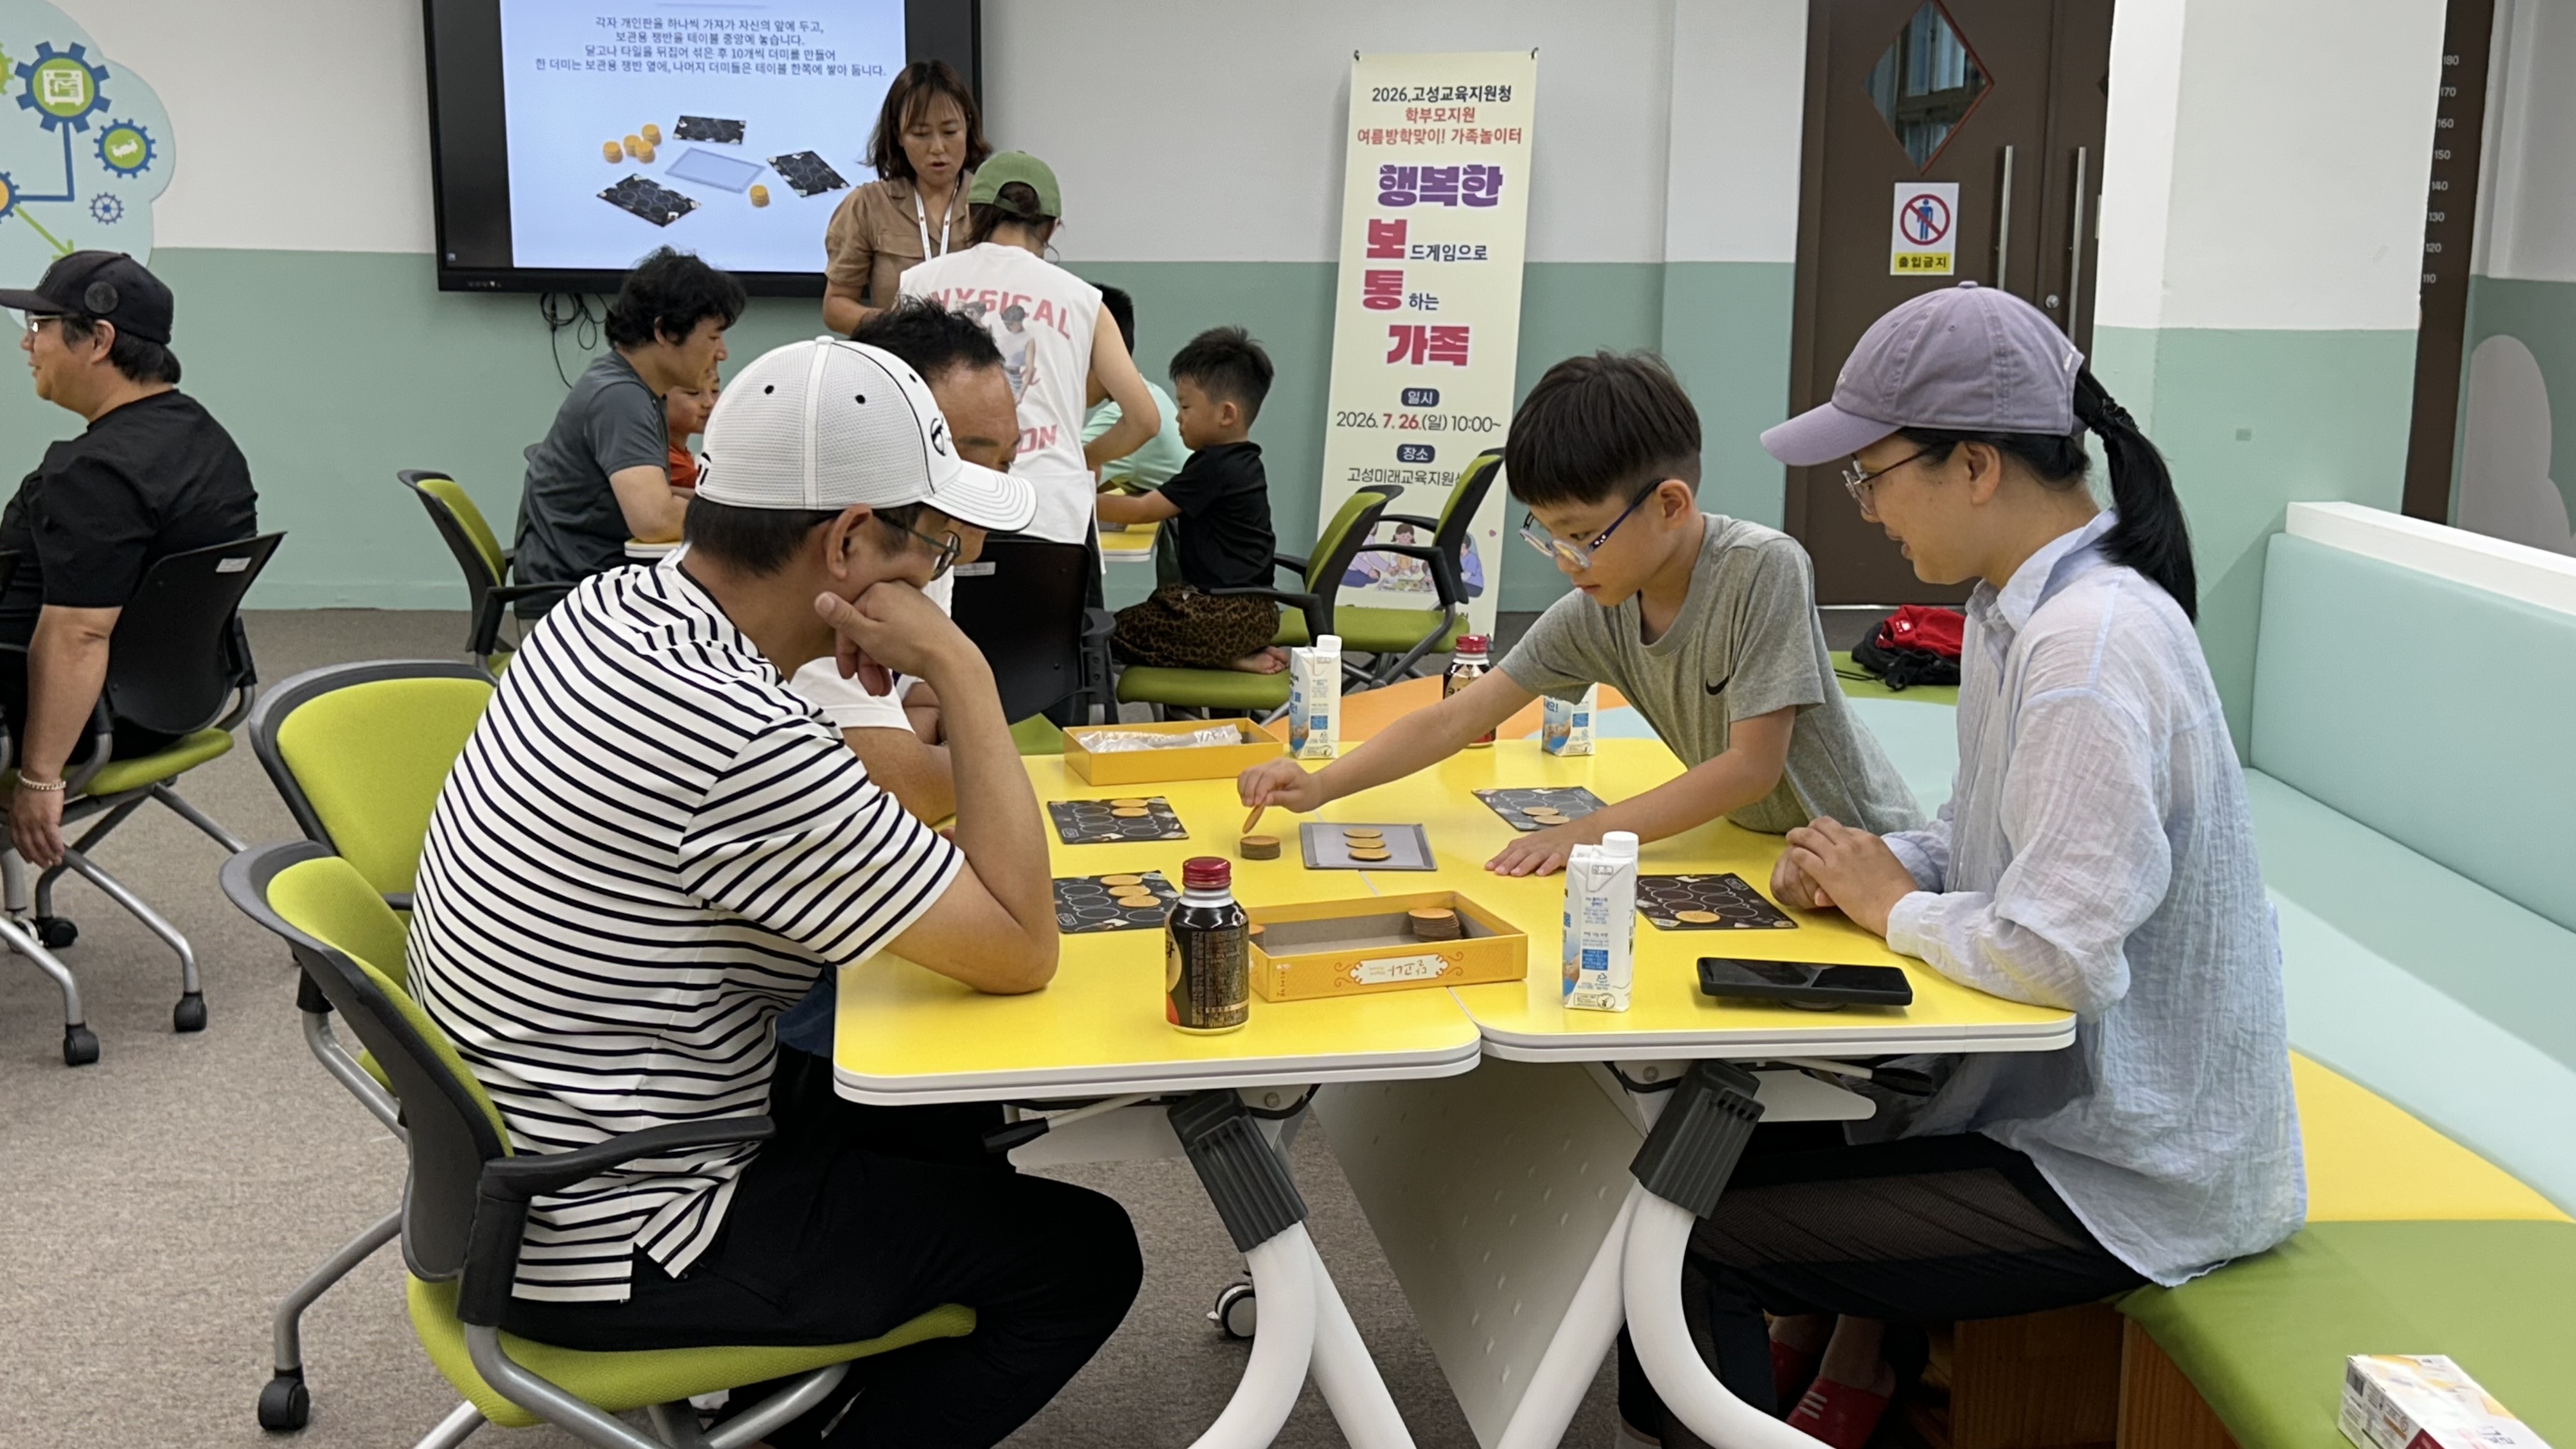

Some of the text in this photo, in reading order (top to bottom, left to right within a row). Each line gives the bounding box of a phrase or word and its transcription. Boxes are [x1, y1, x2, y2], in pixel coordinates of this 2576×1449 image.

[595, 16, 824, 33] 각자 개인판을 하나씩 가져가 자신의 앞에 두고,
[616, 30, 805, 46] 보관용 쟁반을 테이블 중앙에 놓습니다.
[585, 43, 836, 61] 달고나 타일을 뒤집어 섞은 후 10개씩 더미를 만들어
[536, 57, 886, 77] 한 더미는 보관용 쟁반 옆에, 나머지 더미들은 테이블 한쪽에 쌓아 둡니다.
[2442, 55, 2460, 66] 180
[1371, 84, 1512, 103] 2026.고성교육지원청
[2440, 86, 2457, 97] 170
[1405, 107, 1476, 123] 학부모지원
[2437, 118, 2455, 128] 160
[1357, 128, 1522, 145] 여름방학맞이! 가족놀이터
[2434, 150, 2451, 160] 150
[1377, 164, 1503, 208] 행복한
[2431, 181, 2449, 191] 140
[2428, 212, 2445, 222] 130
[2425, 243, 2442, 253] 120
[1898, 256, 1947, 268] 출입금지
[2423, 273, 2437, 284] 110
[924, 288, 1071, 340] HYSICAL
[1386, 324, 1469, 366] 가족
[1407, 390, 1433, 405] 일시
[1337, 411, 1378, 428] 2026.
[1452, 415, 1502, 433] 10:00~
[1402, 447, 1429, 461] 장소
